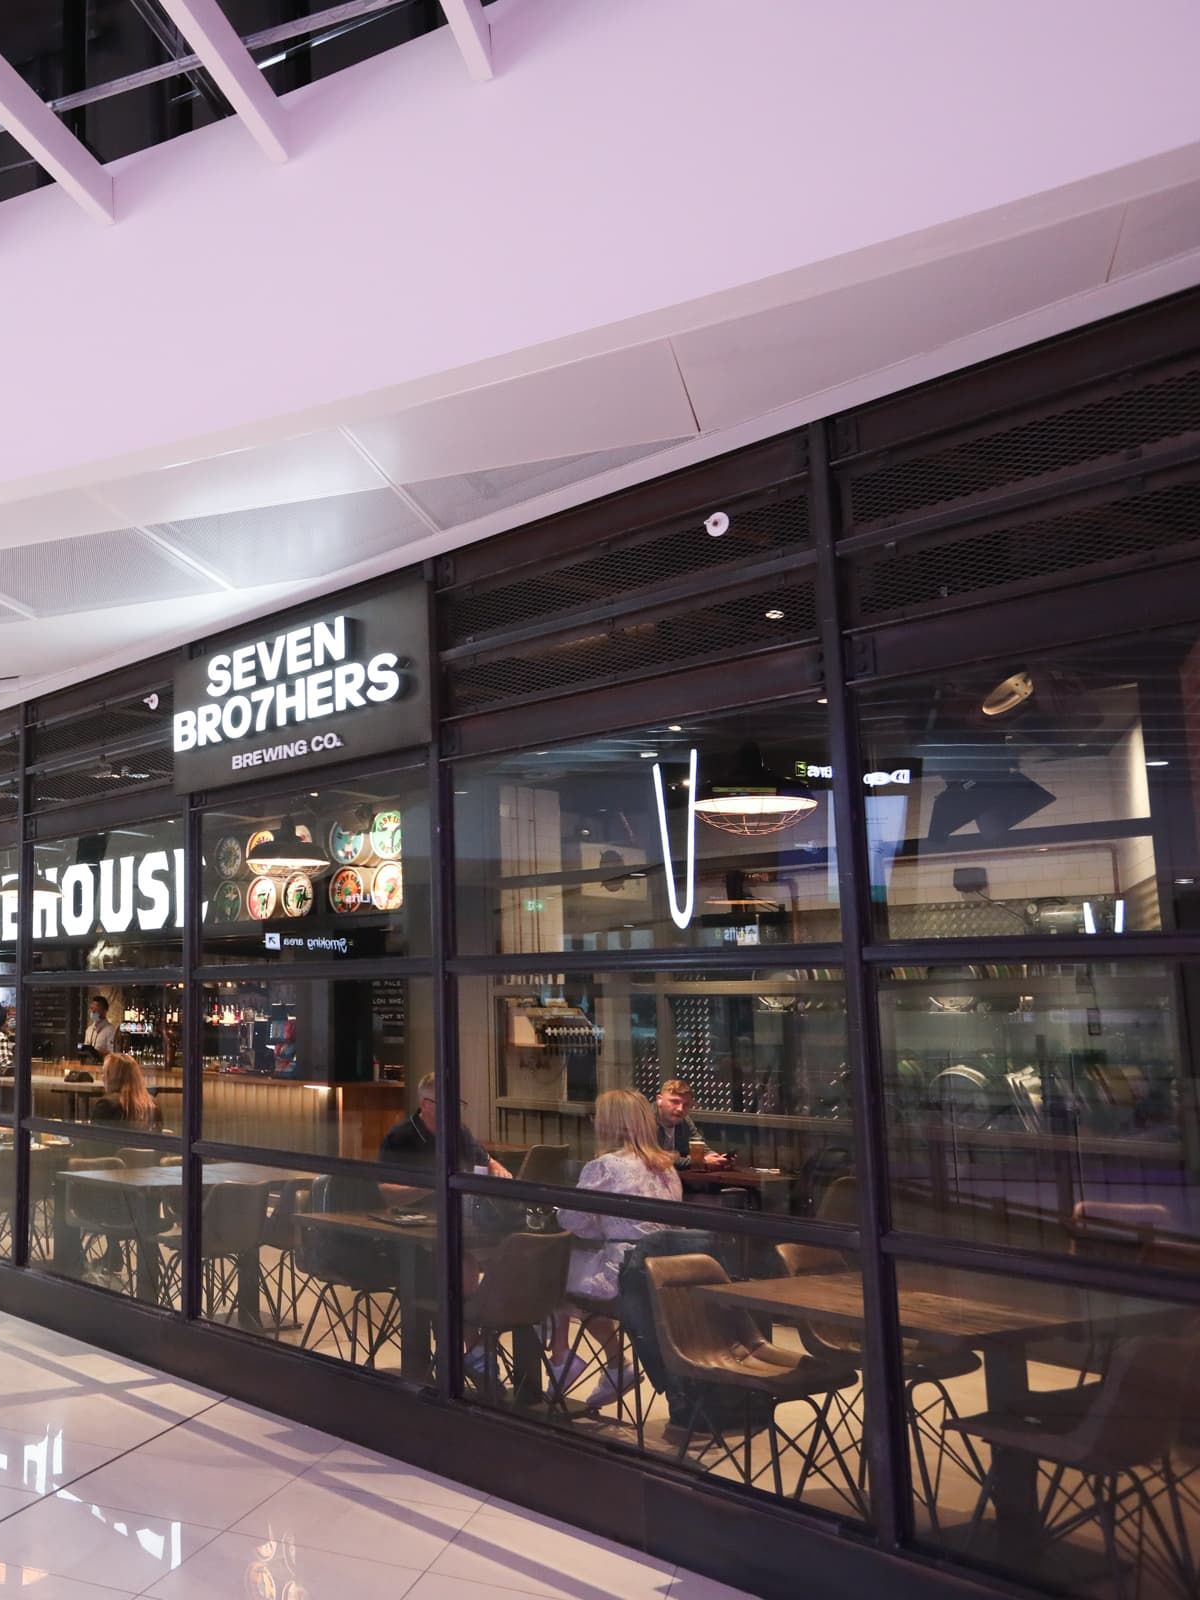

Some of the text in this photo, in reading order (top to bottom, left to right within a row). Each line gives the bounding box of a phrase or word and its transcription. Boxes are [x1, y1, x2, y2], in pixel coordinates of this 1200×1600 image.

[205, 615, 347, 698] SEVEN
[172, 652, 402, 754] BRO7HERS
[231, 732, 343, 771] BREWING CO.
